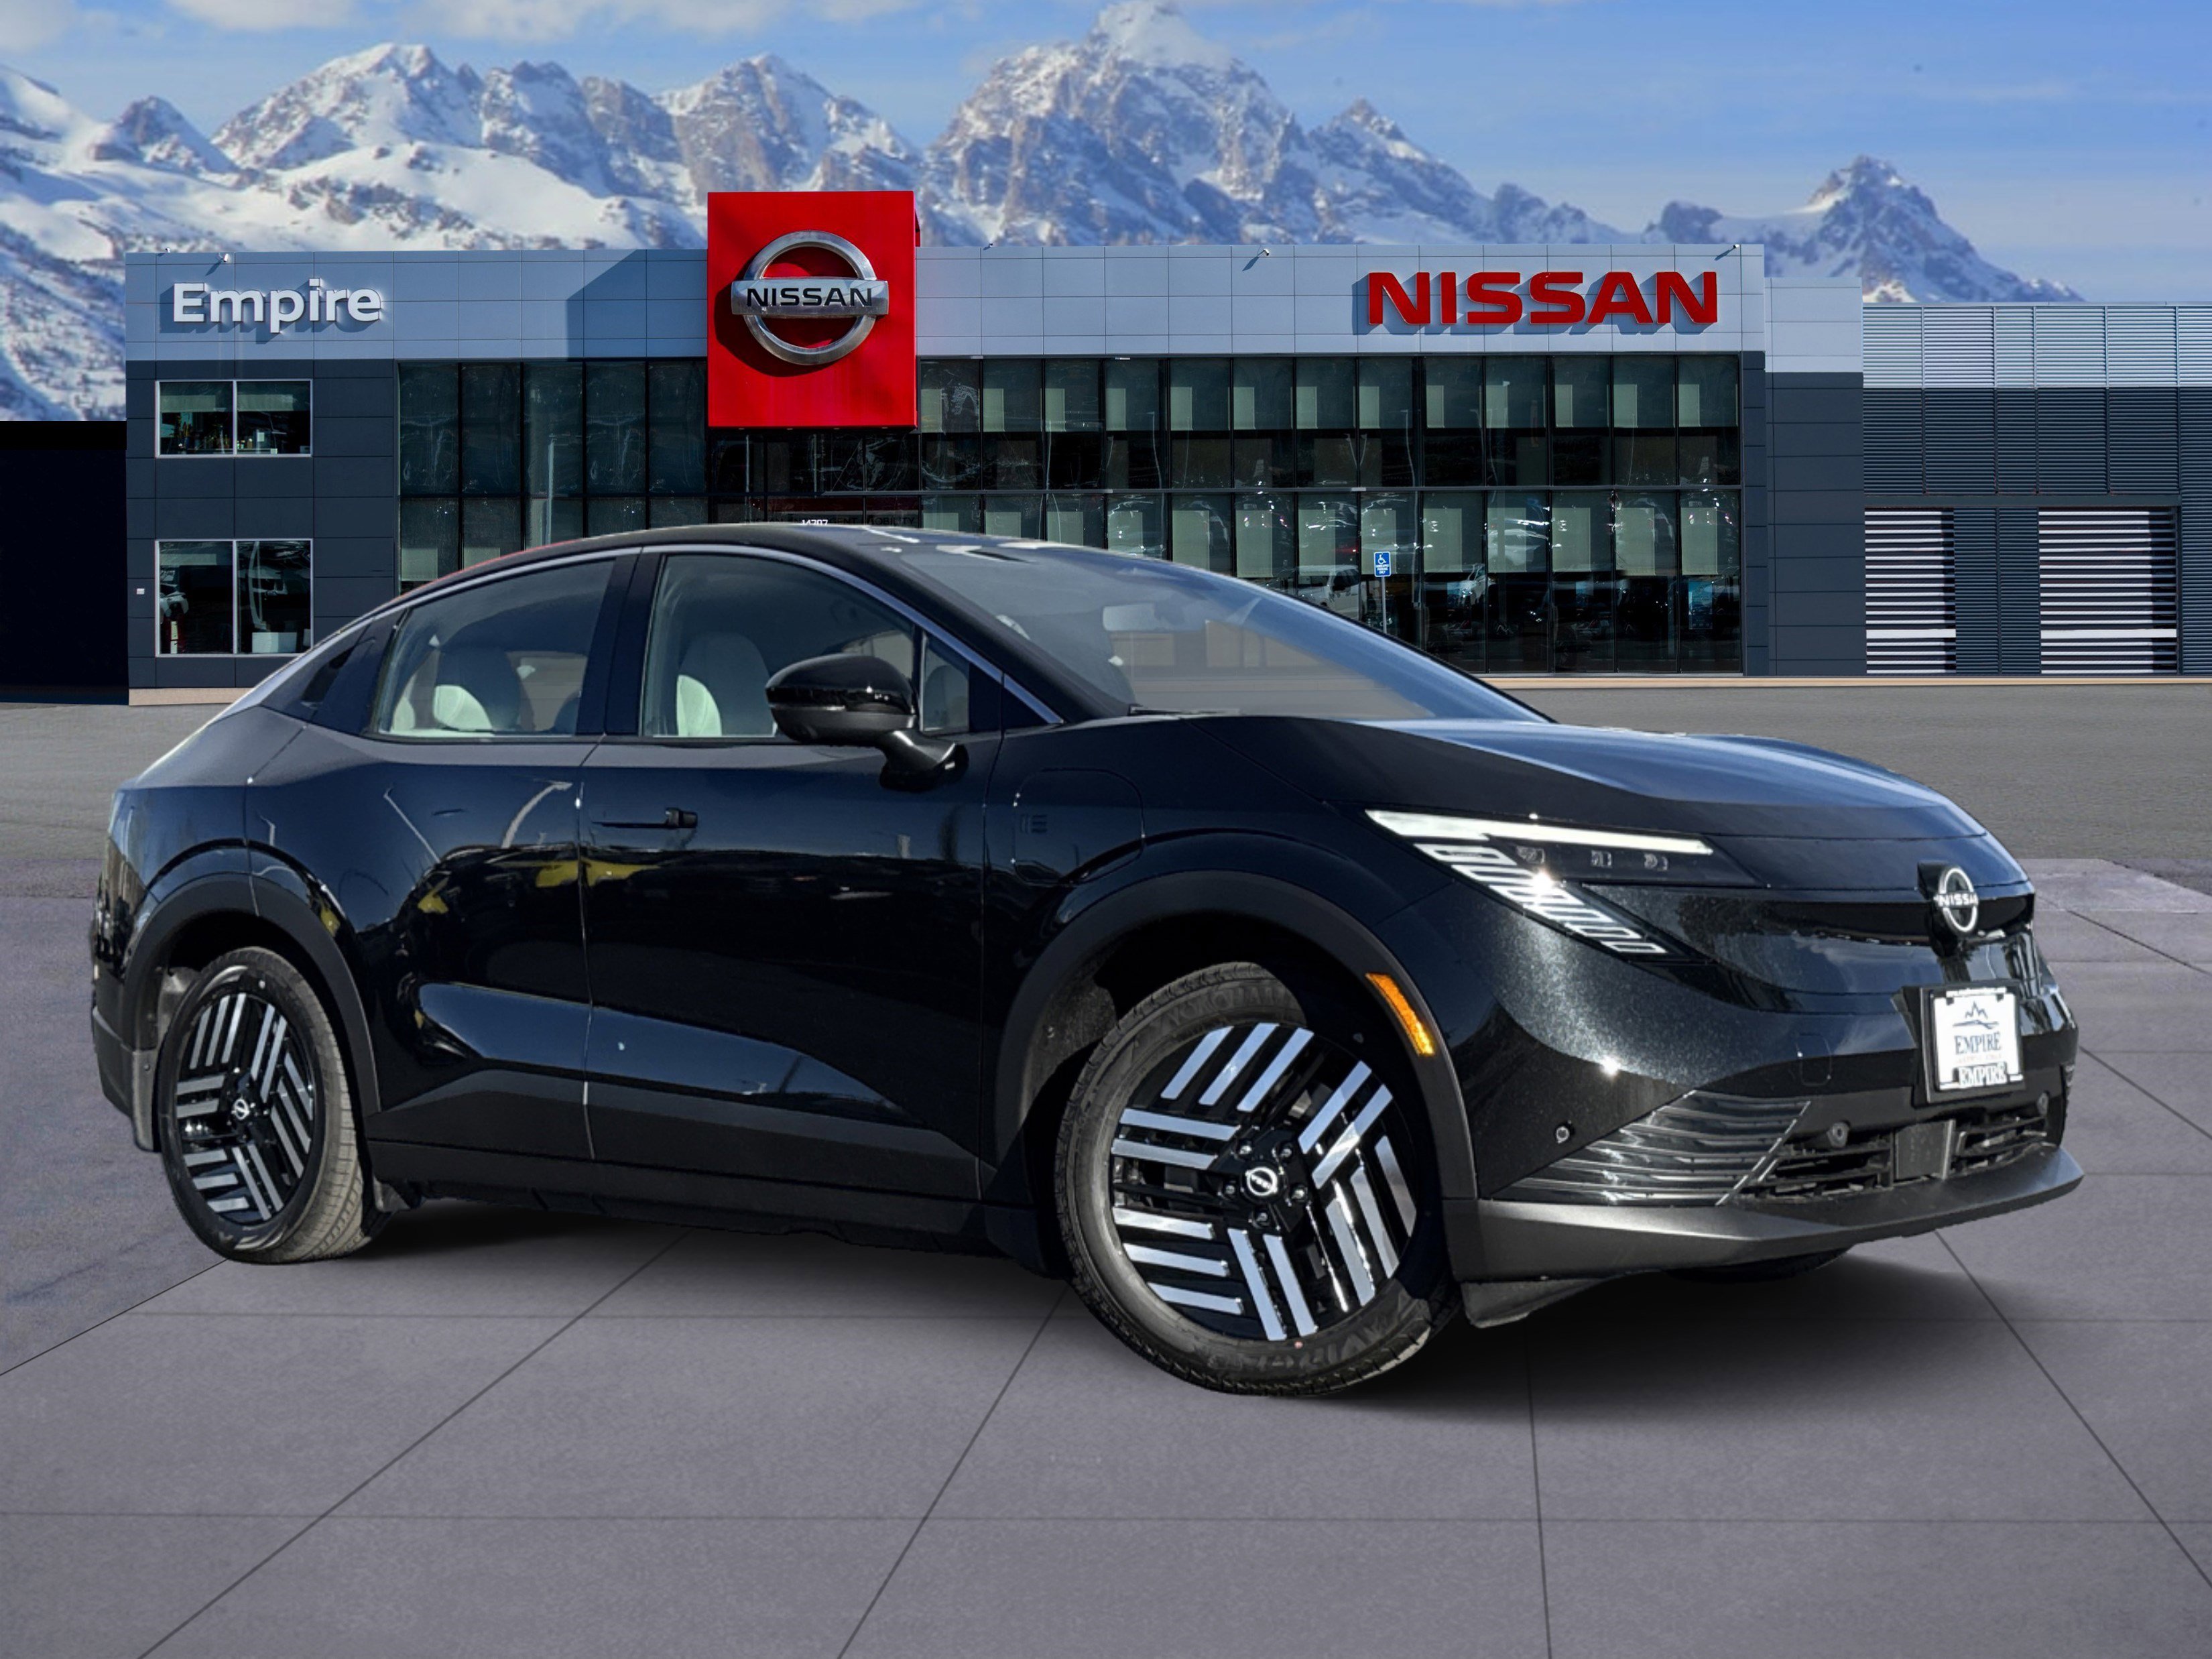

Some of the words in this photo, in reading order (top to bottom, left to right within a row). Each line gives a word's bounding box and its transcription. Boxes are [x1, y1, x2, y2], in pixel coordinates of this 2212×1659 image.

[174, 278, 381, 333] Empire
[747, 288, 871, 306] NISSAN
[1368, 271, 1717, 324] NISSAN
[1954, 1032, 2002, 1054] EMPIRE
